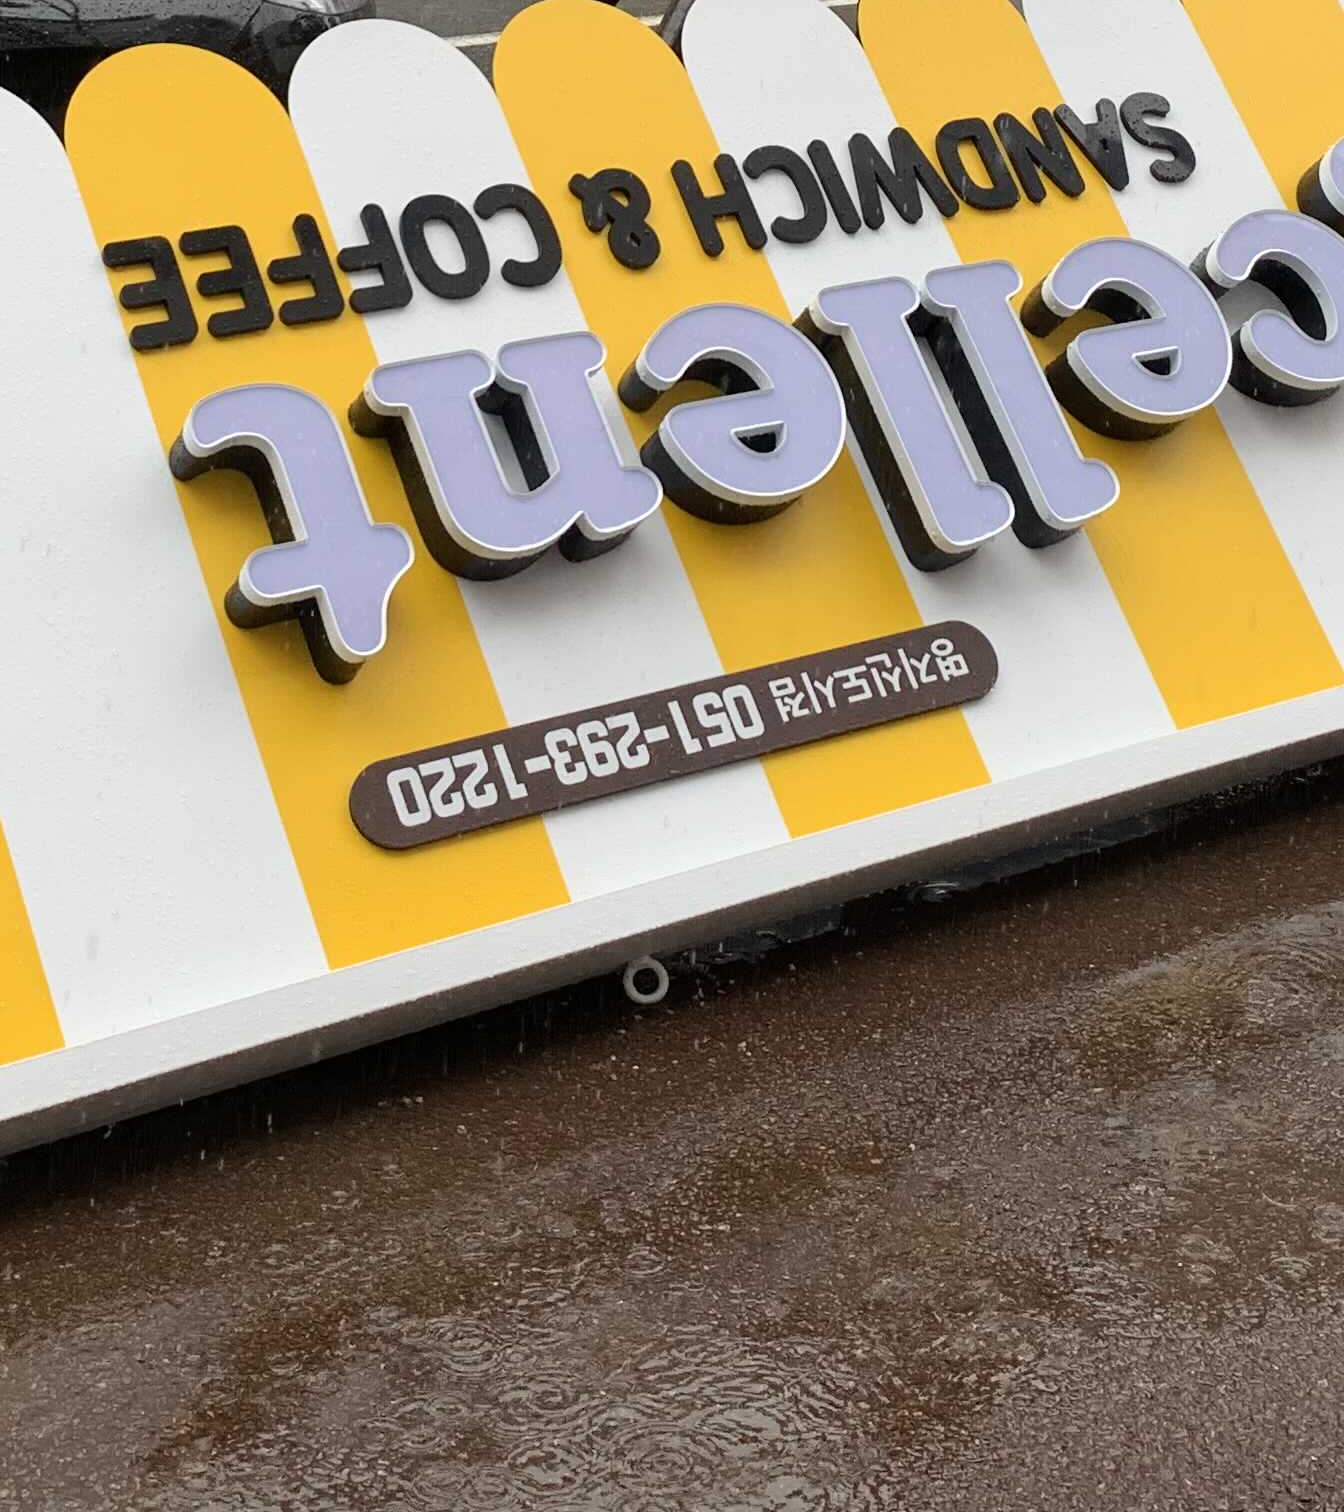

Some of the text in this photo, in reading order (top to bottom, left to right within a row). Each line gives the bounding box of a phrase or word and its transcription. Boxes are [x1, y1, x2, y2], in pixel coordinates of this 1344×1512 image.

[102, 91, 1197, 351] SANDWICH & COFFEE
[385, 637, 969, 828] 명지신도시점 051-293-1220
